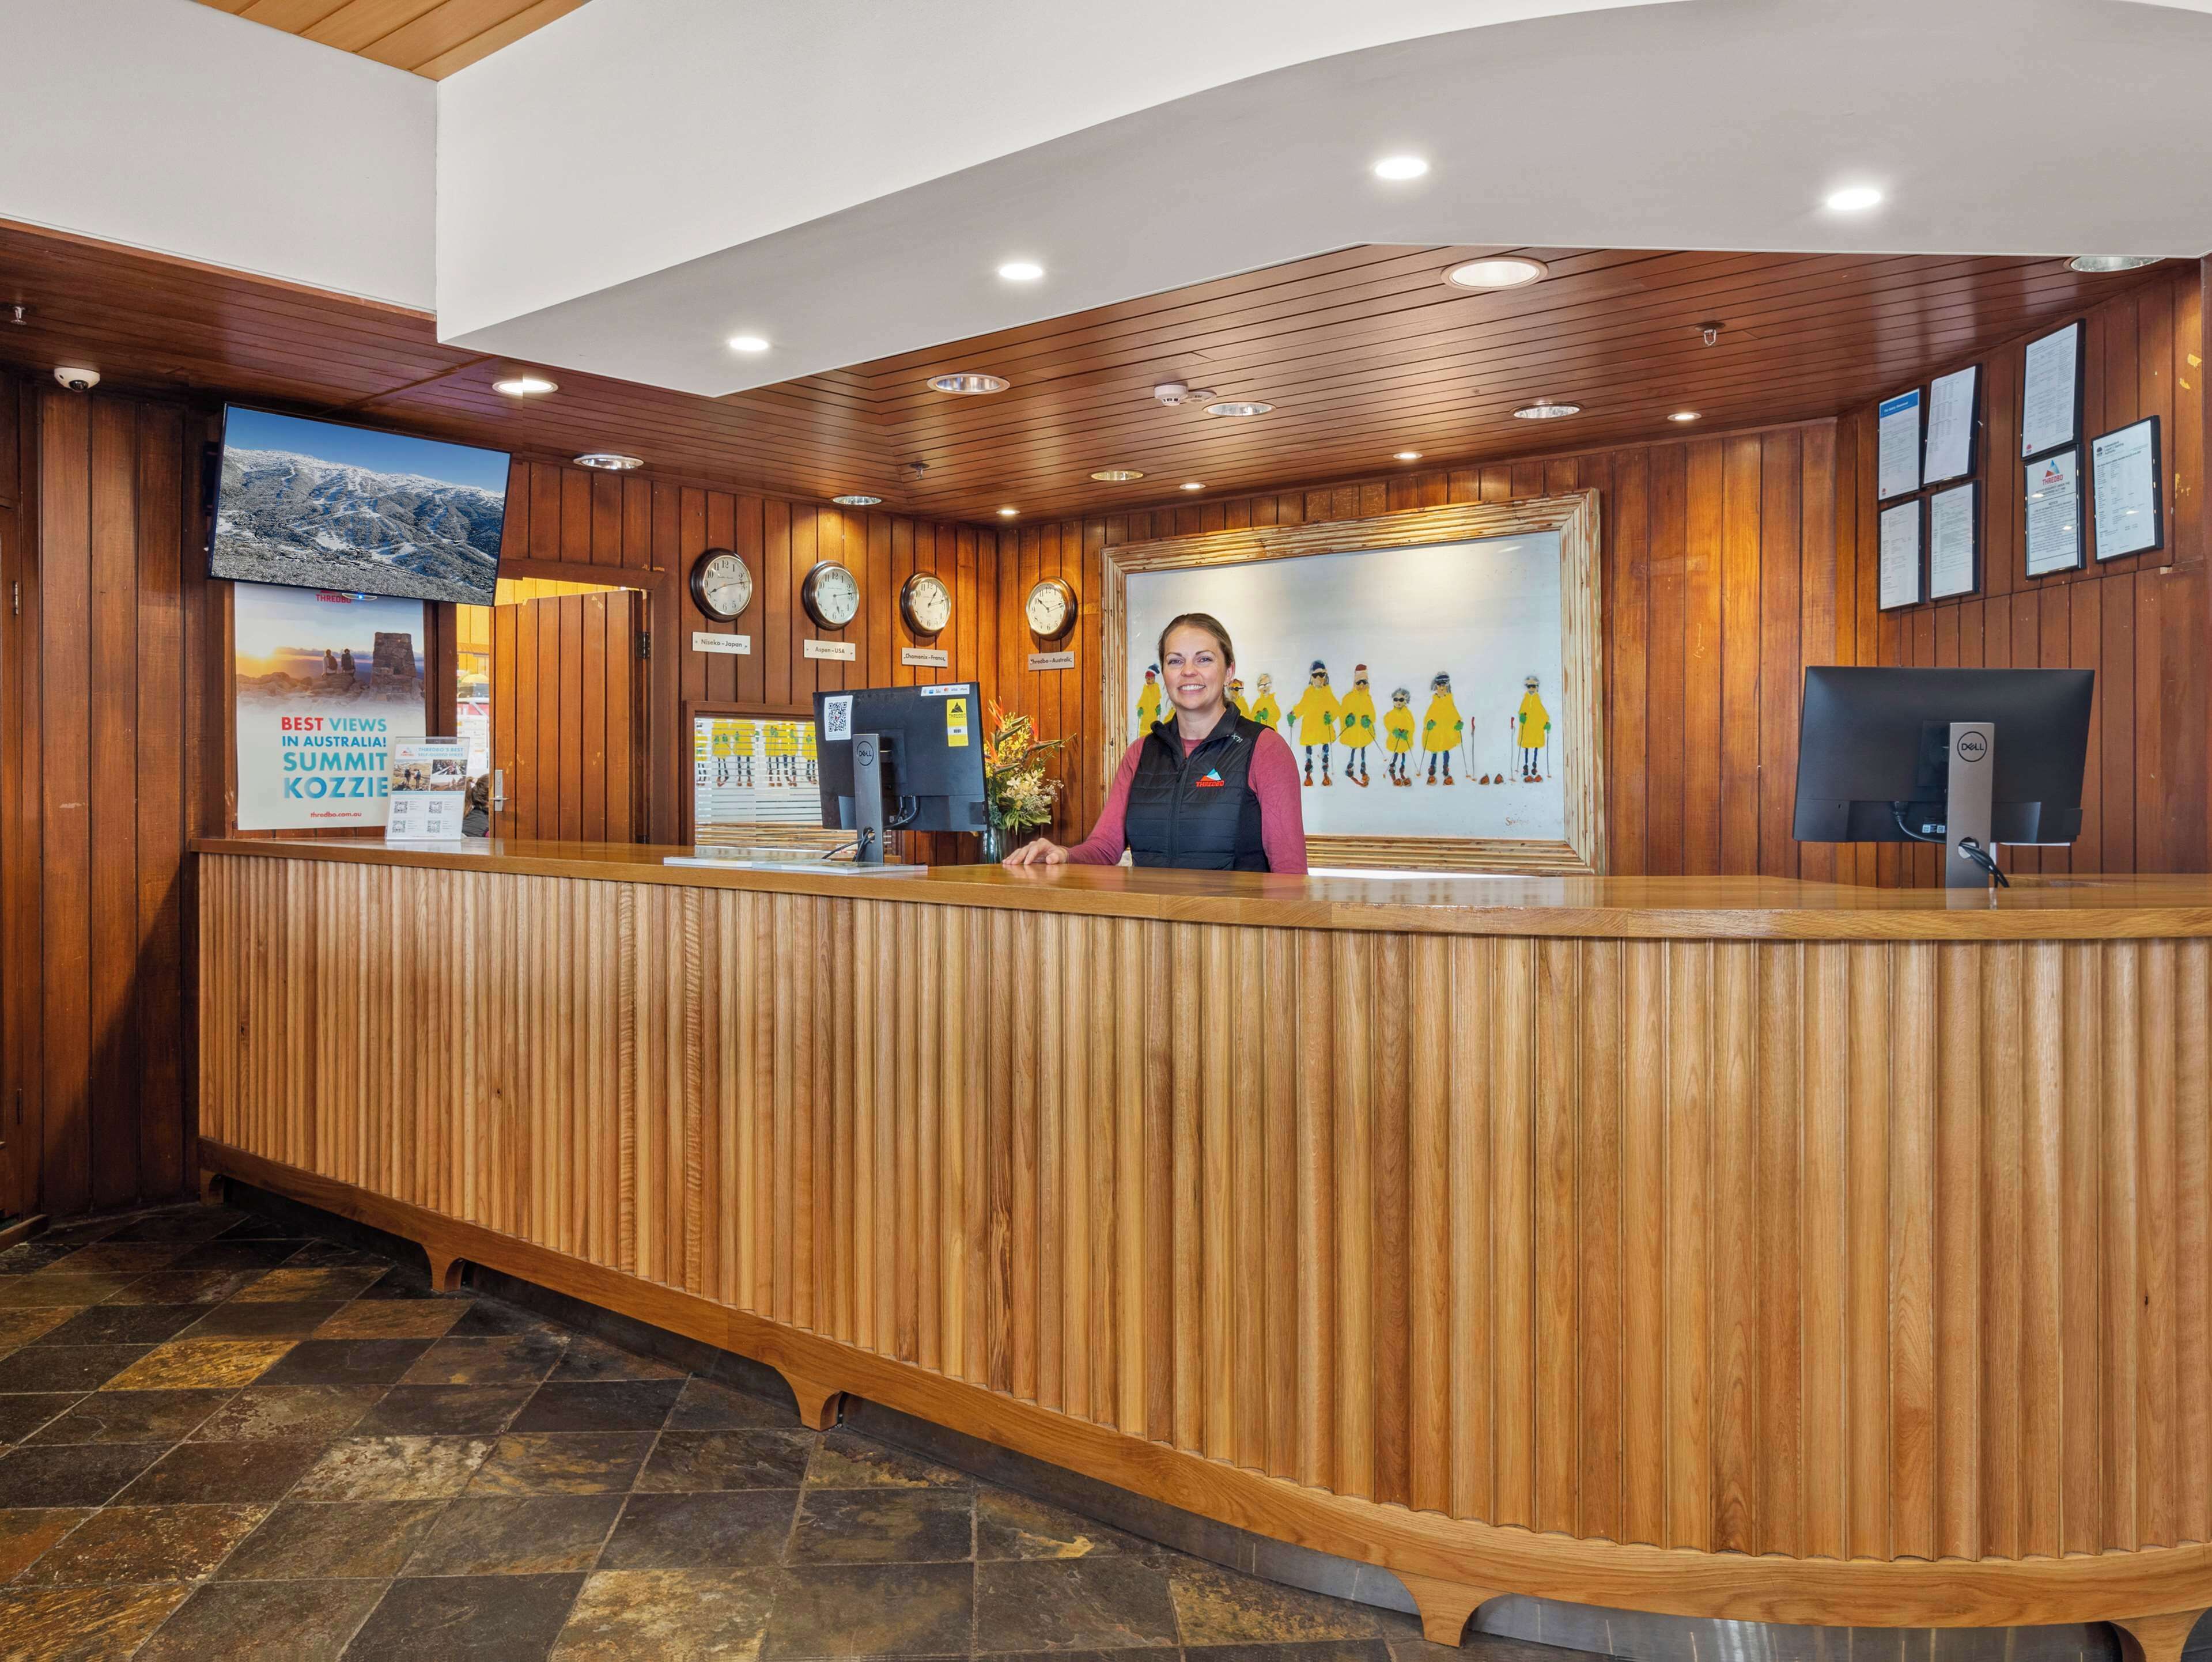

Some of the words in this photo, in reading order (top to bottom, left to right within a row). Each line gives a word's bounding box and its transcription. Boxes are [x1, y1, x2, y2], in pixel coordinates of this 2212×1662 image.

[2042, 474, 2063, 486] THREDBO
[714, 562, 719, 571] 11
[721, 560, 729, 569] 12
[732, 564, 735, 572] 1
[707, 570, 714, 578] 10
[738, 573, 743, 581] 2
[831, 571, 838, 580] 12
[847, 584, 851, 592] 2
[282, 717, 324, 731] BEST
[328, 718, 387, 732] VIEWS
[282, 736, 298, 747] IN
[303, 736, 387, 747] AUSTRALIA!
[283, 752, 388, 771] SUMMIT
[284, 777, 388, 799] KOZZIE
